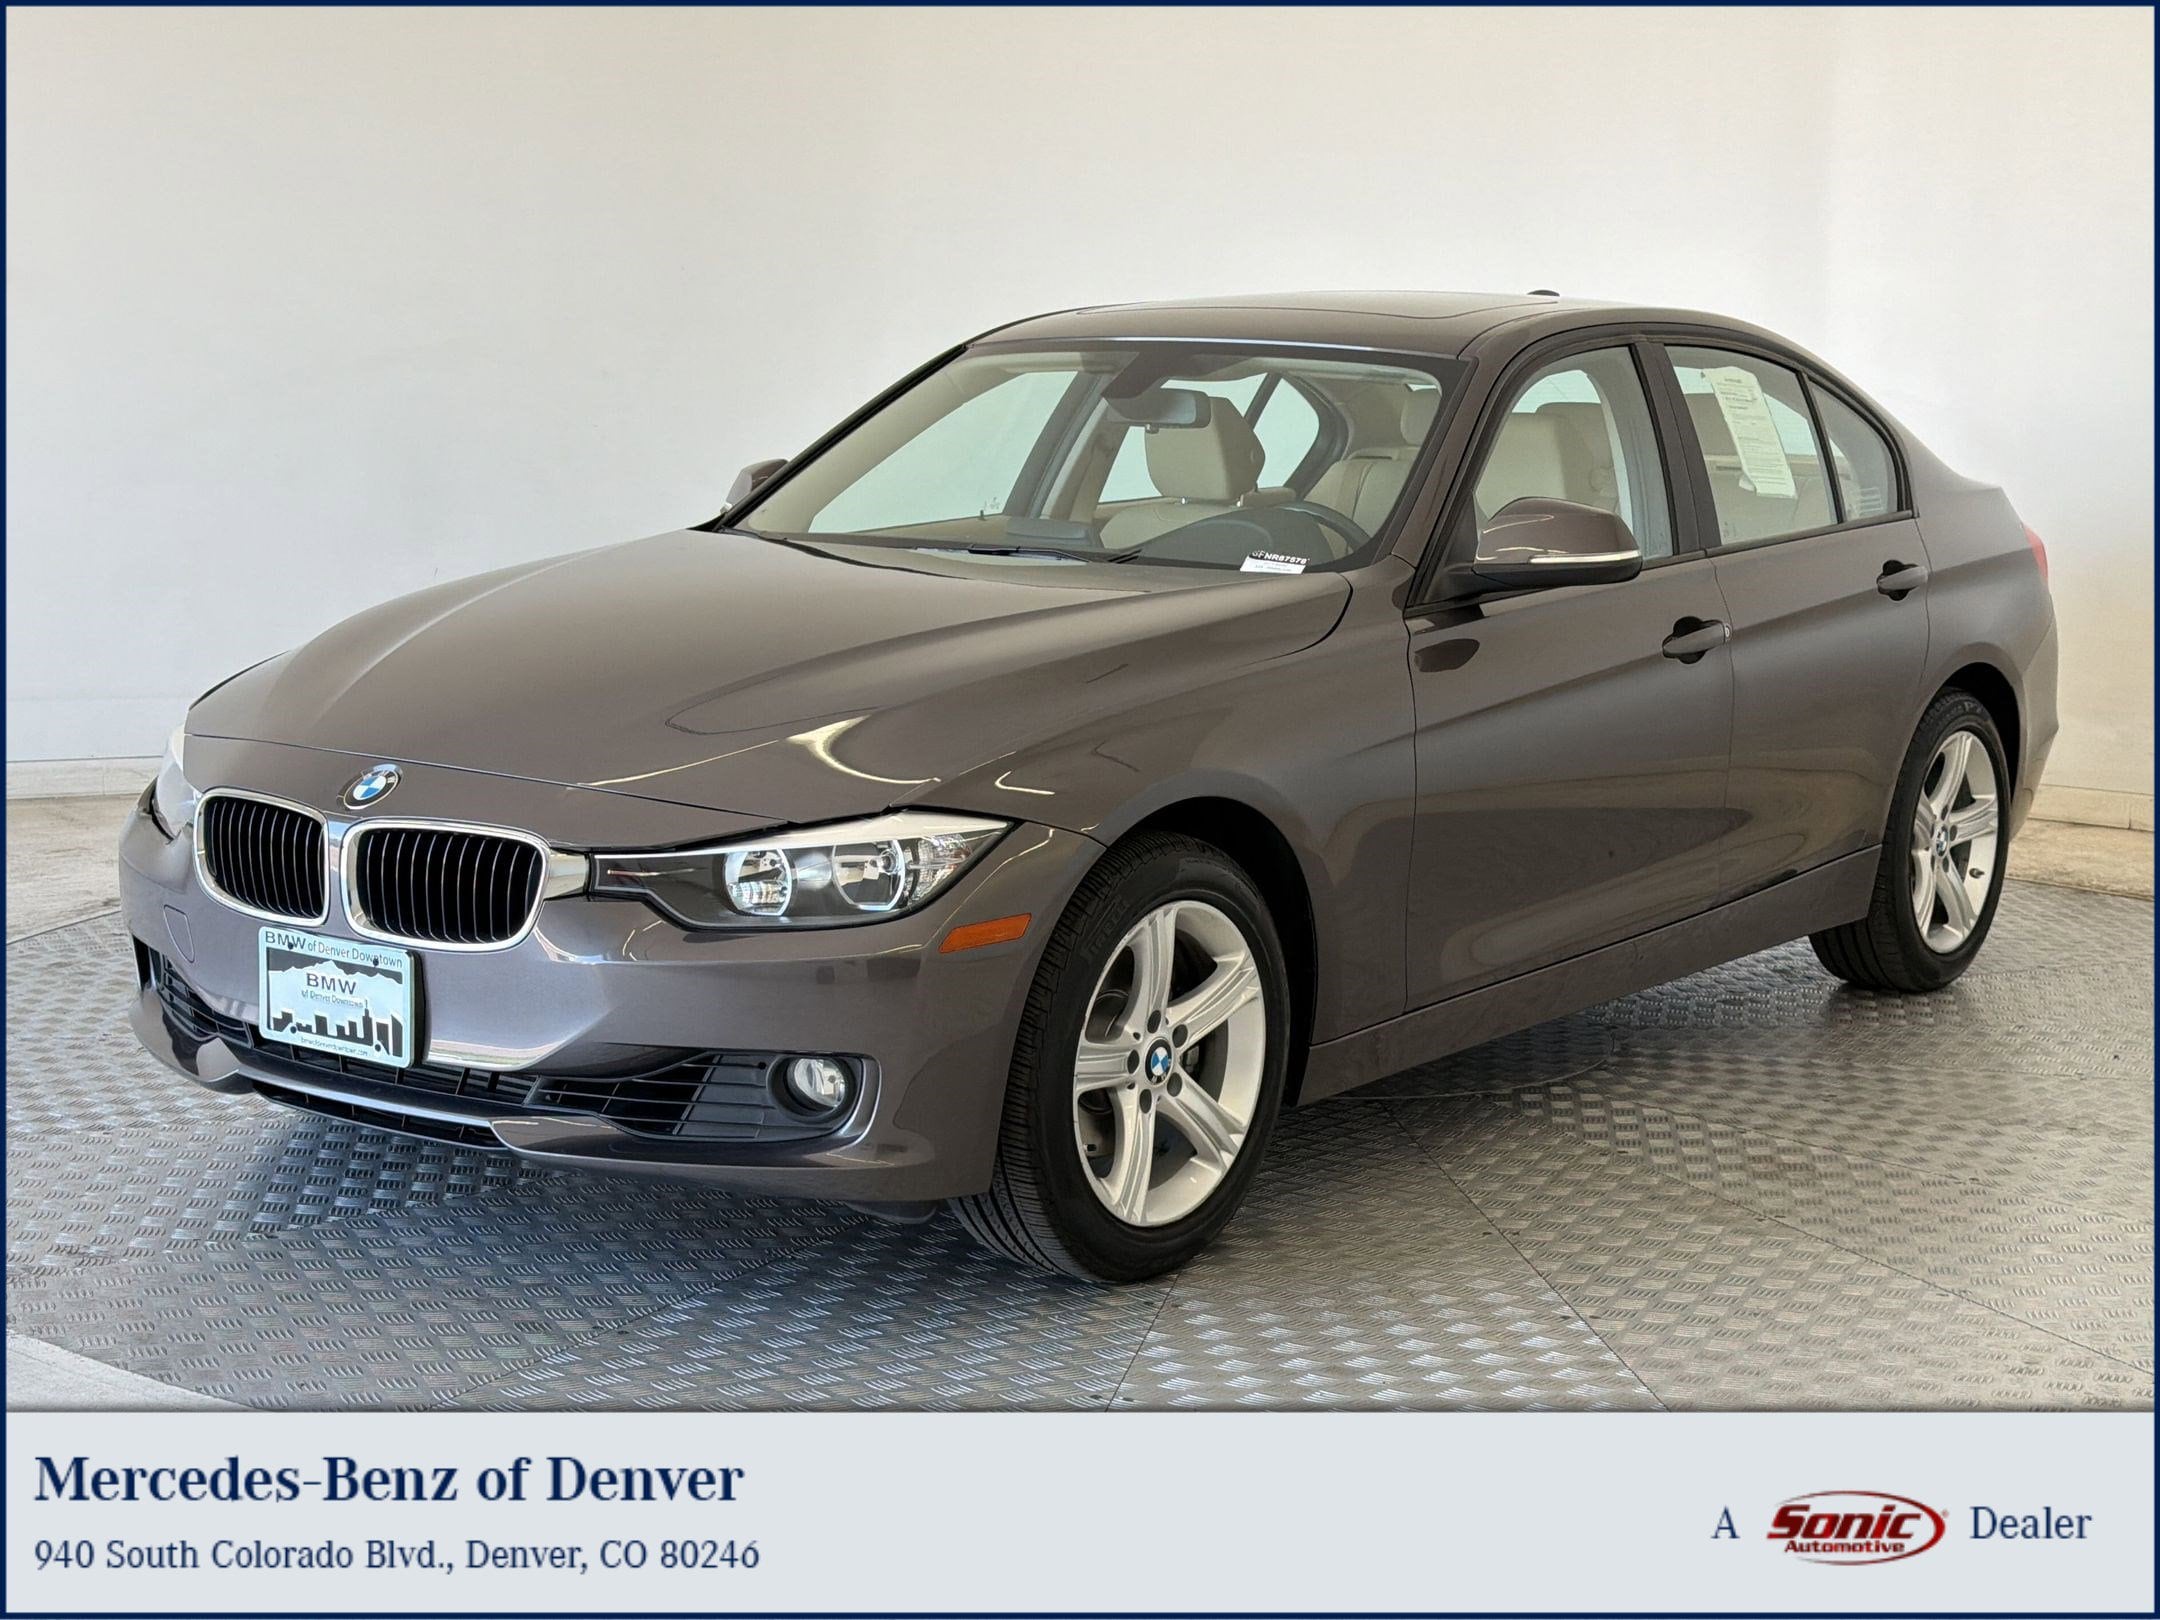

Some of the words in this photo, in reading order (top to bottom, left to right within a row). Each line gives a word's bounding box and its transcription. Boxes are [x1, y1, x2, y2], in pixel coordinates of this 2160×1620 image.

[265, 930, 306, 950] BMW
[308, 941, 317, 952] of
[318, 941, 350, 958] Denver
[306, 972, 357, 995] BMW
